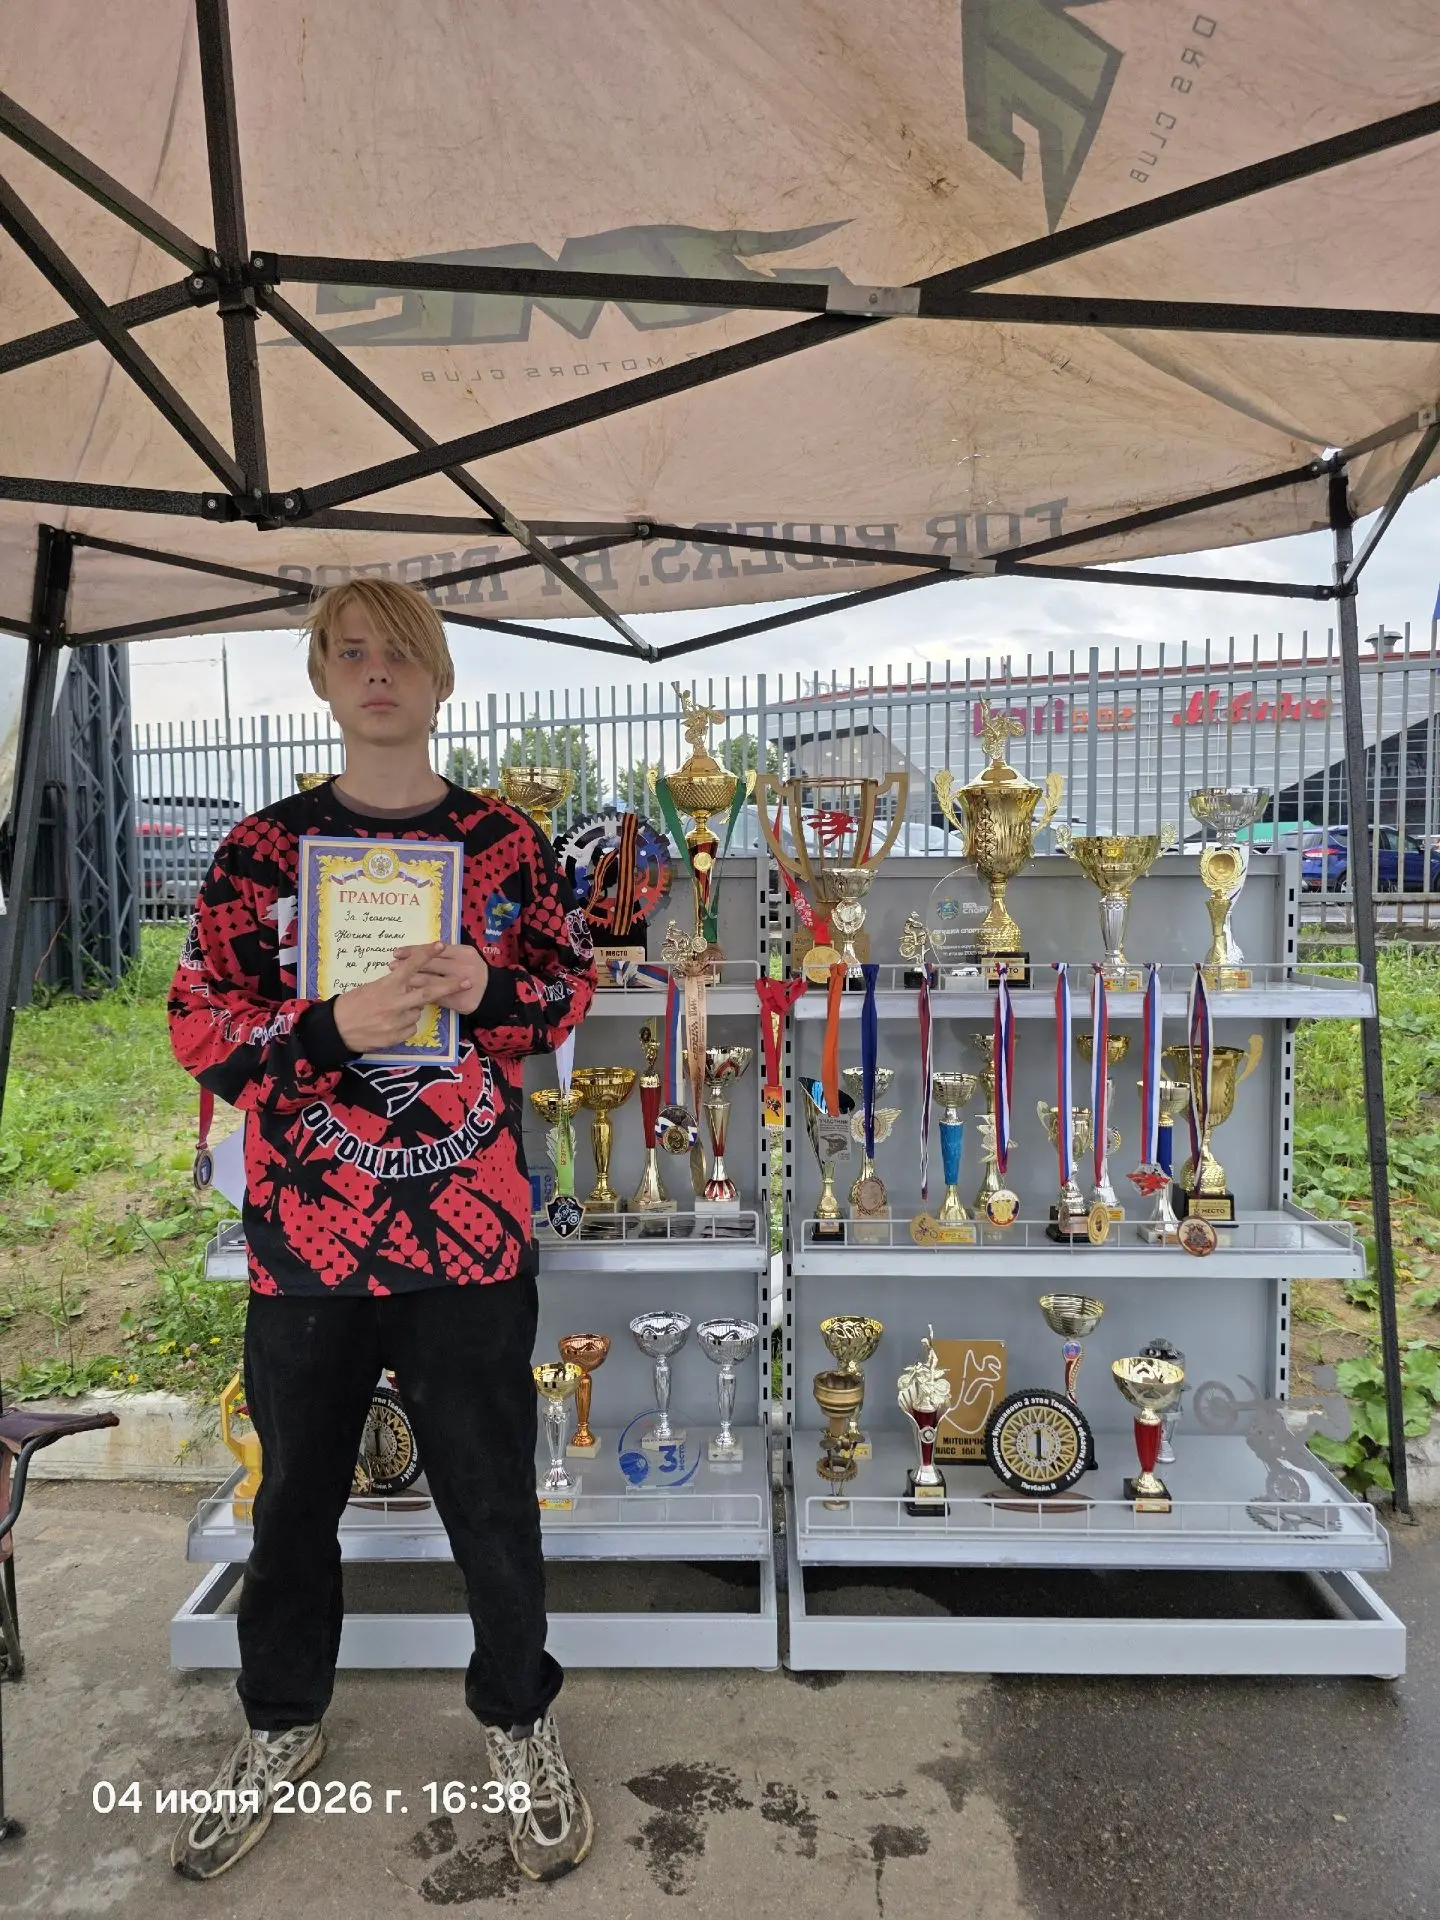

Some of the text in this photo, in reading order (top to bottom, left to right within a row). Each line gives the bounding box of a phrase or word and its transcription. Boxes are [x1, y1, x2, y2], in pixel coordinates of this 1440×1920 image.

[338, 890, 421, 907] ГРАМОТА
[560, 1224, 567, 1235] 1
[1034, 1427, 1047, 1461] 1
[658, 1444, 678, 1473] 3
